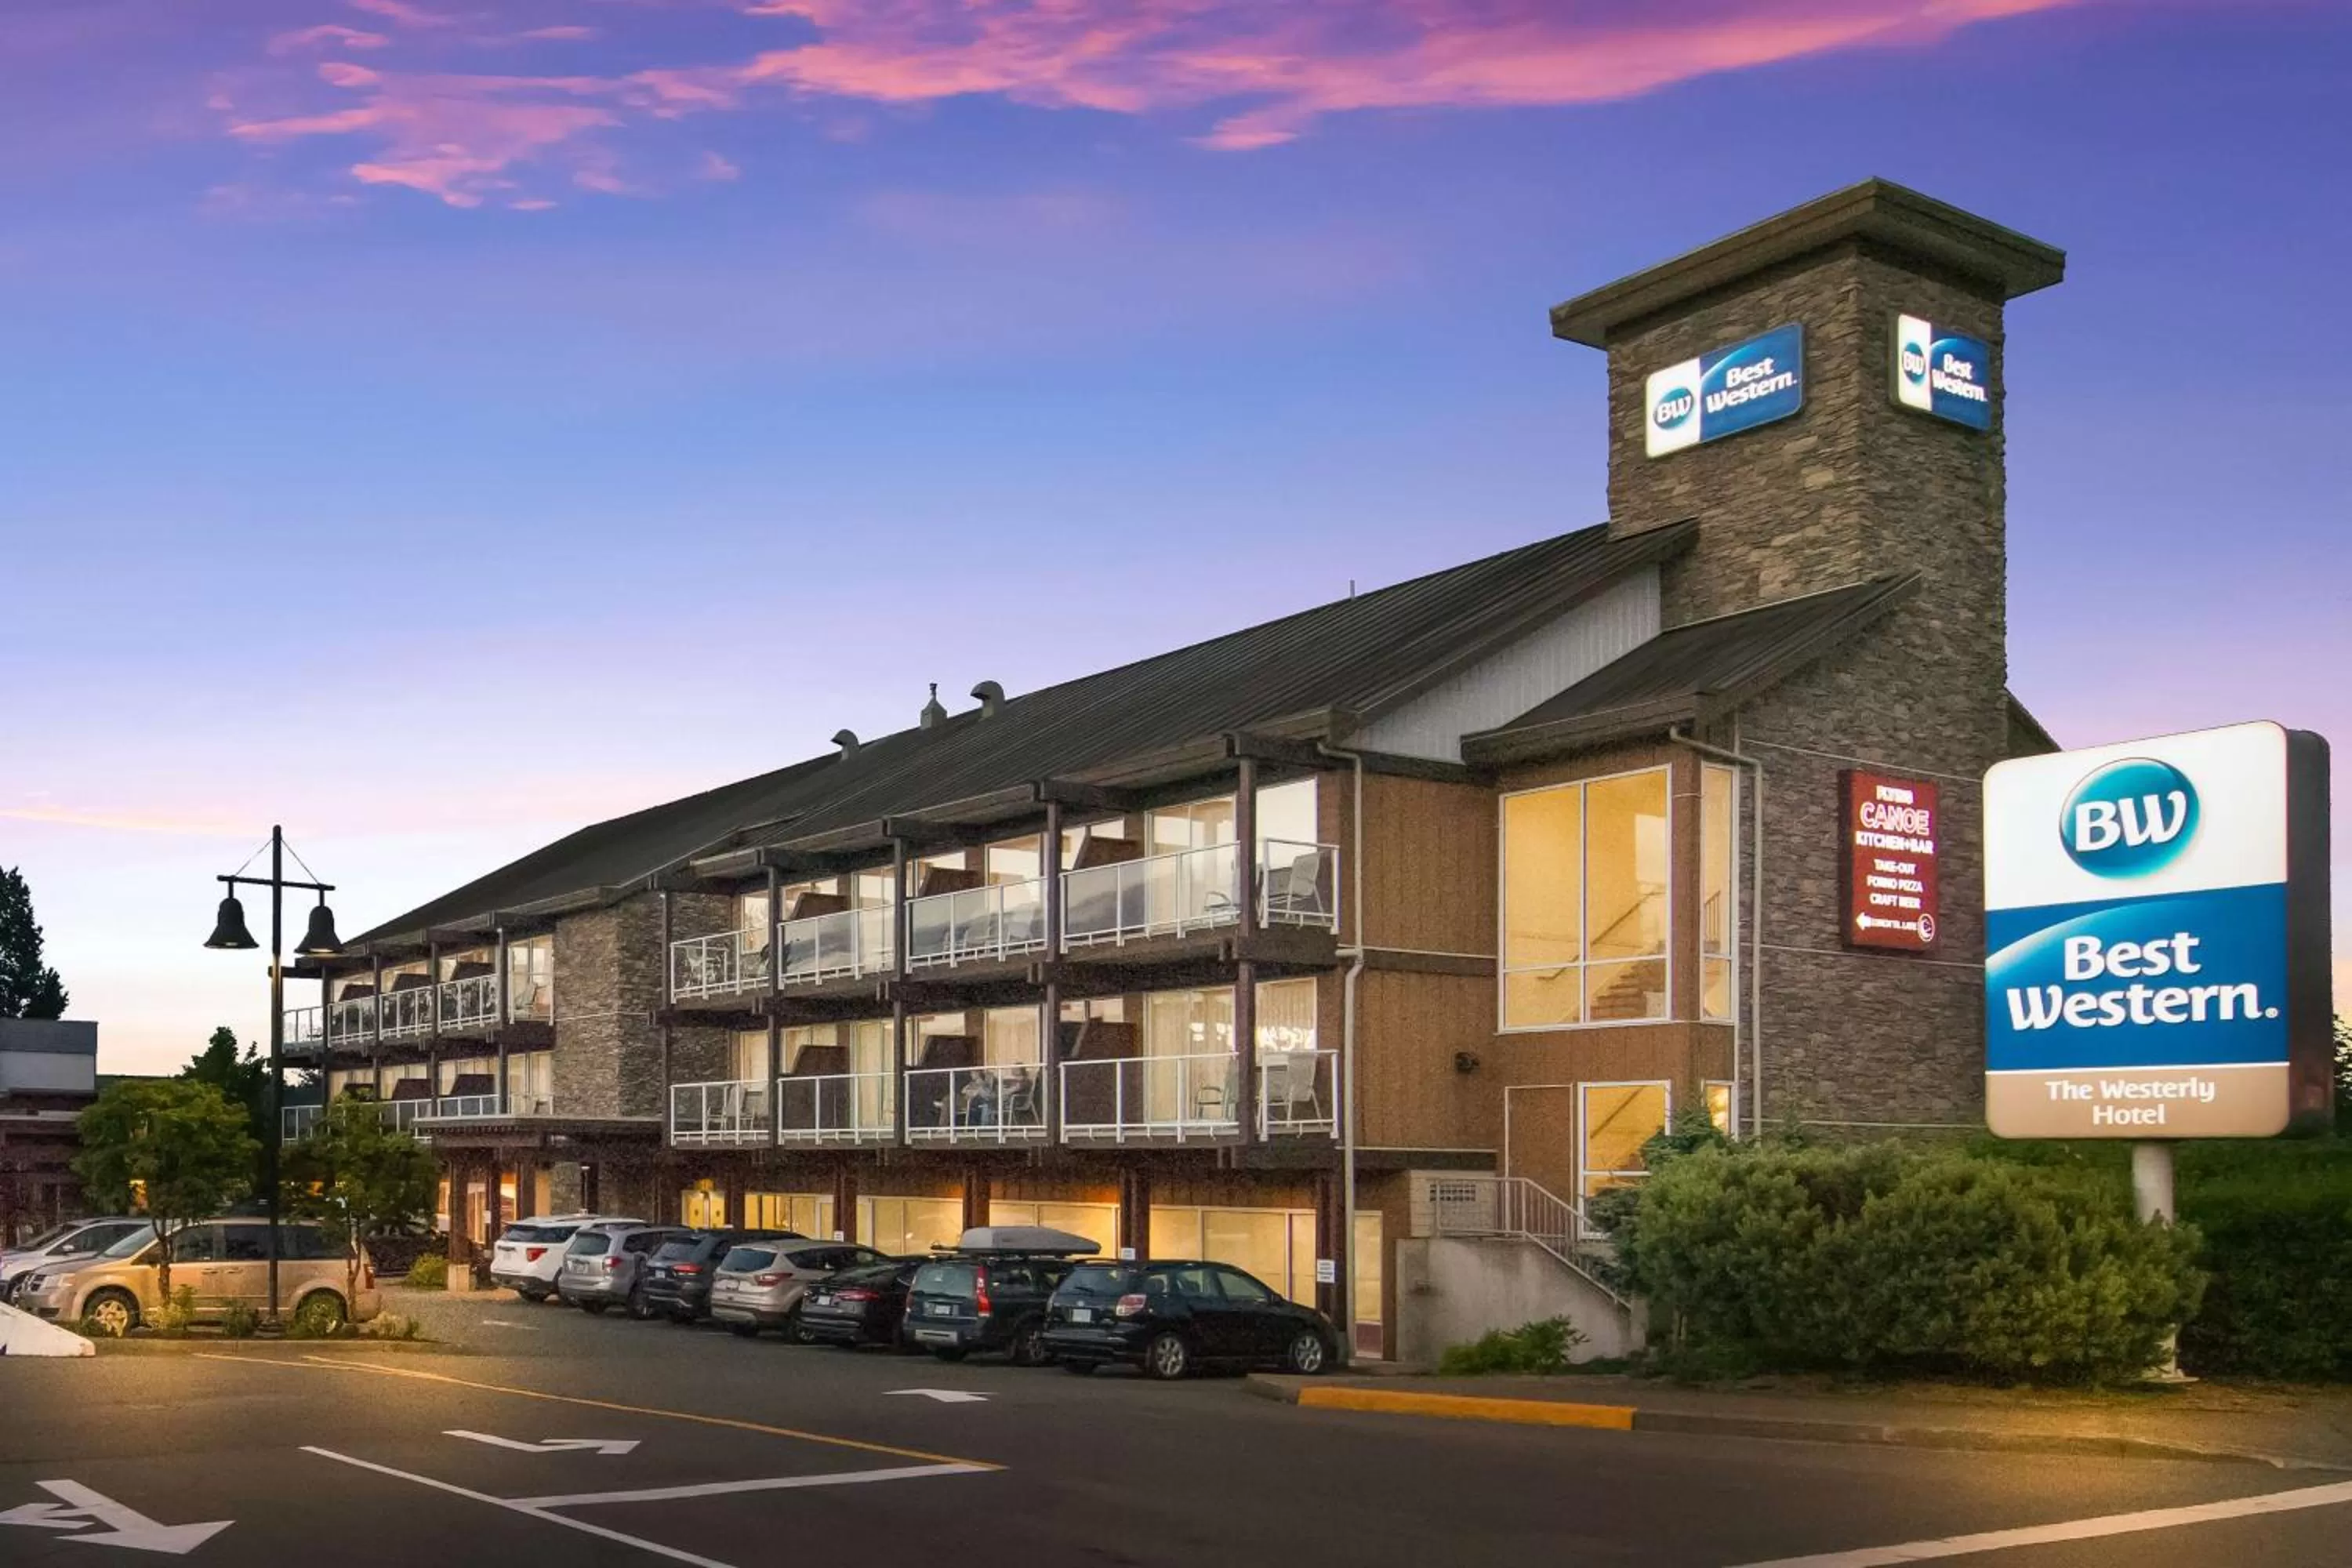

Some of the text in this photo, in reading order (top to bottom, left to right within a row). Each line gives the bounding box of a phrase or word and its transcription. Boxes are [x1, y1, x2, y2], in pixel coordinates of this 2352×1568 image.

[1726, 356, 1775, 385] Best
[1902, 350, 1926, 376] BW
[1943, 353, 1973, 379] Best
[1657, 394, 1692, 425] BW
[1860, 801, 1930, 836] CANOE
[2074, 789, 2187, 852] BW
[2064, 932, 2201, 981] Best
[2045, 1077, 2216, 1103] The Westerly
[2092, 1103, 2165, 1126] Hotel
